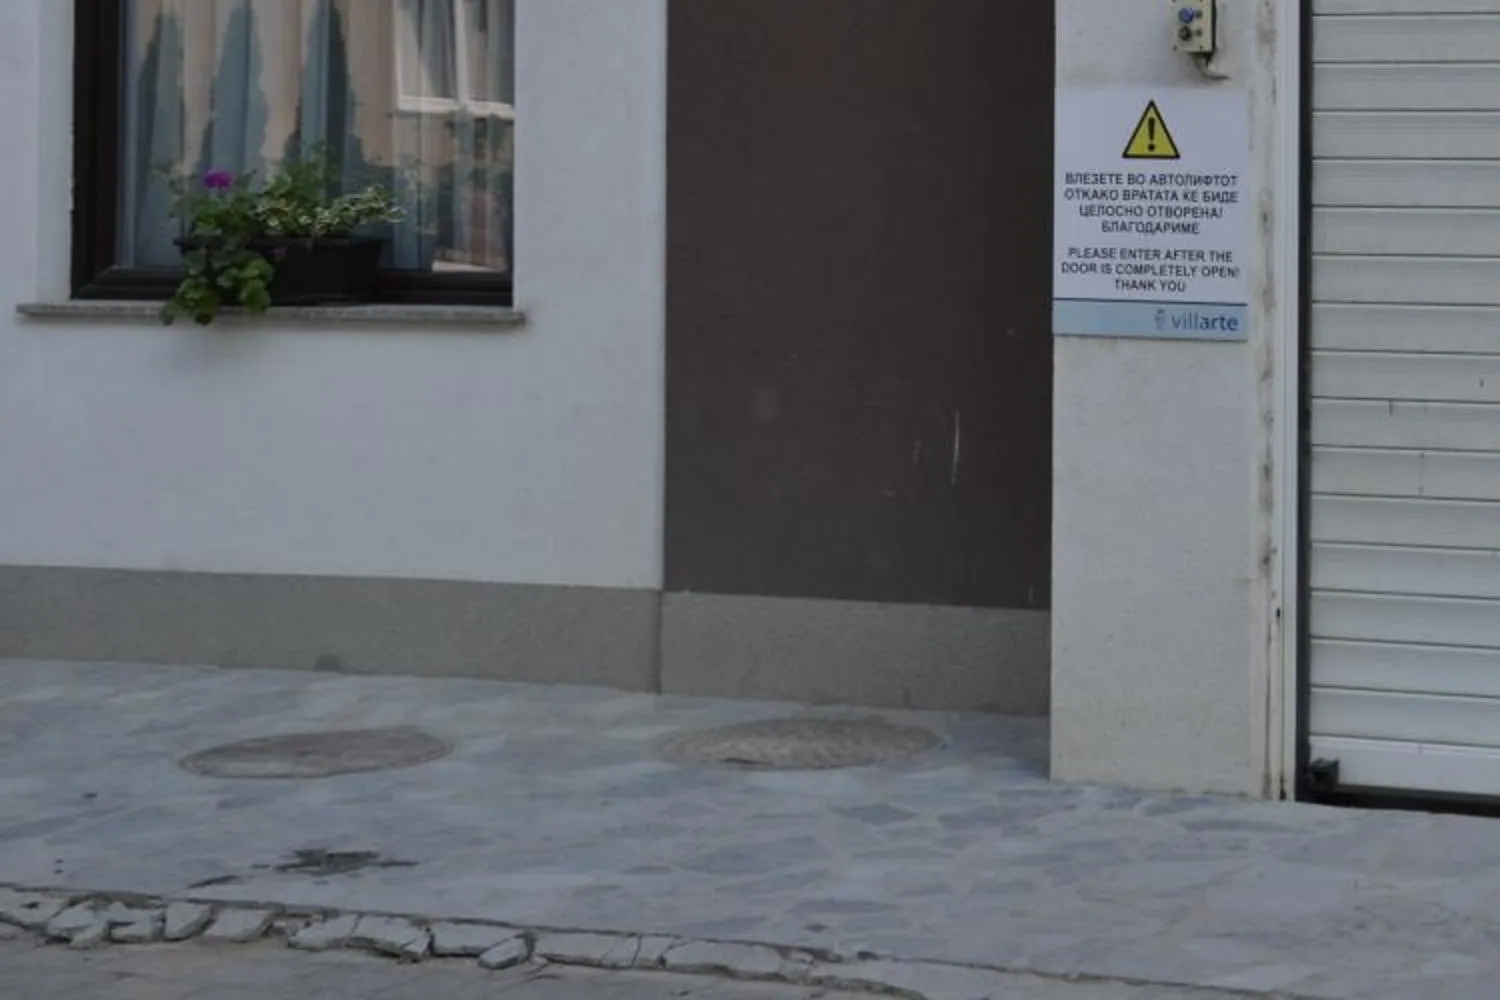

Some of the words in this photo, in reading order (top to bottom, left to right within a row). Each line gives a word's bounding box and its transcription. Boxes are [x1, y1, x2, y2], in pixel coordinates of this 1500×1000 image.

[1065, 172, 1123, 185] ВЛЕЗЕТЕ
[1127, 172, 1146, 185] ВО
[1150, 173, 1238, 187] АВТОЛИФТОТ
[1064, 188, 1119, 201] ОТКАКО
[1122, 189, 1179, 201] ВРАТАТА
[1203, 190, 1240, 204] БИДЕ
[1079, 204, 1144, 217] ЦЕЛОСНО
[1101, 220, 1200, 235] БЛАГОДАРИМЕ
[1068, 247, 1117, 259] PLEASE
[1119, 247, 1164, 260] ENTER
[1164, 249, 1206, 261] AFTER
[1209, 250, 1233, 263] THE
[1061, 262, 1098, 274] DOOR
[1101, 263, 1113, 275] IS
[1115, 263, 1198, 277] COMPLETELY
[1115, 279, 1157, 292] THANK
[1160, 280, 1186, 293] YOU
[1171, 311, 1239, 332] villarte
